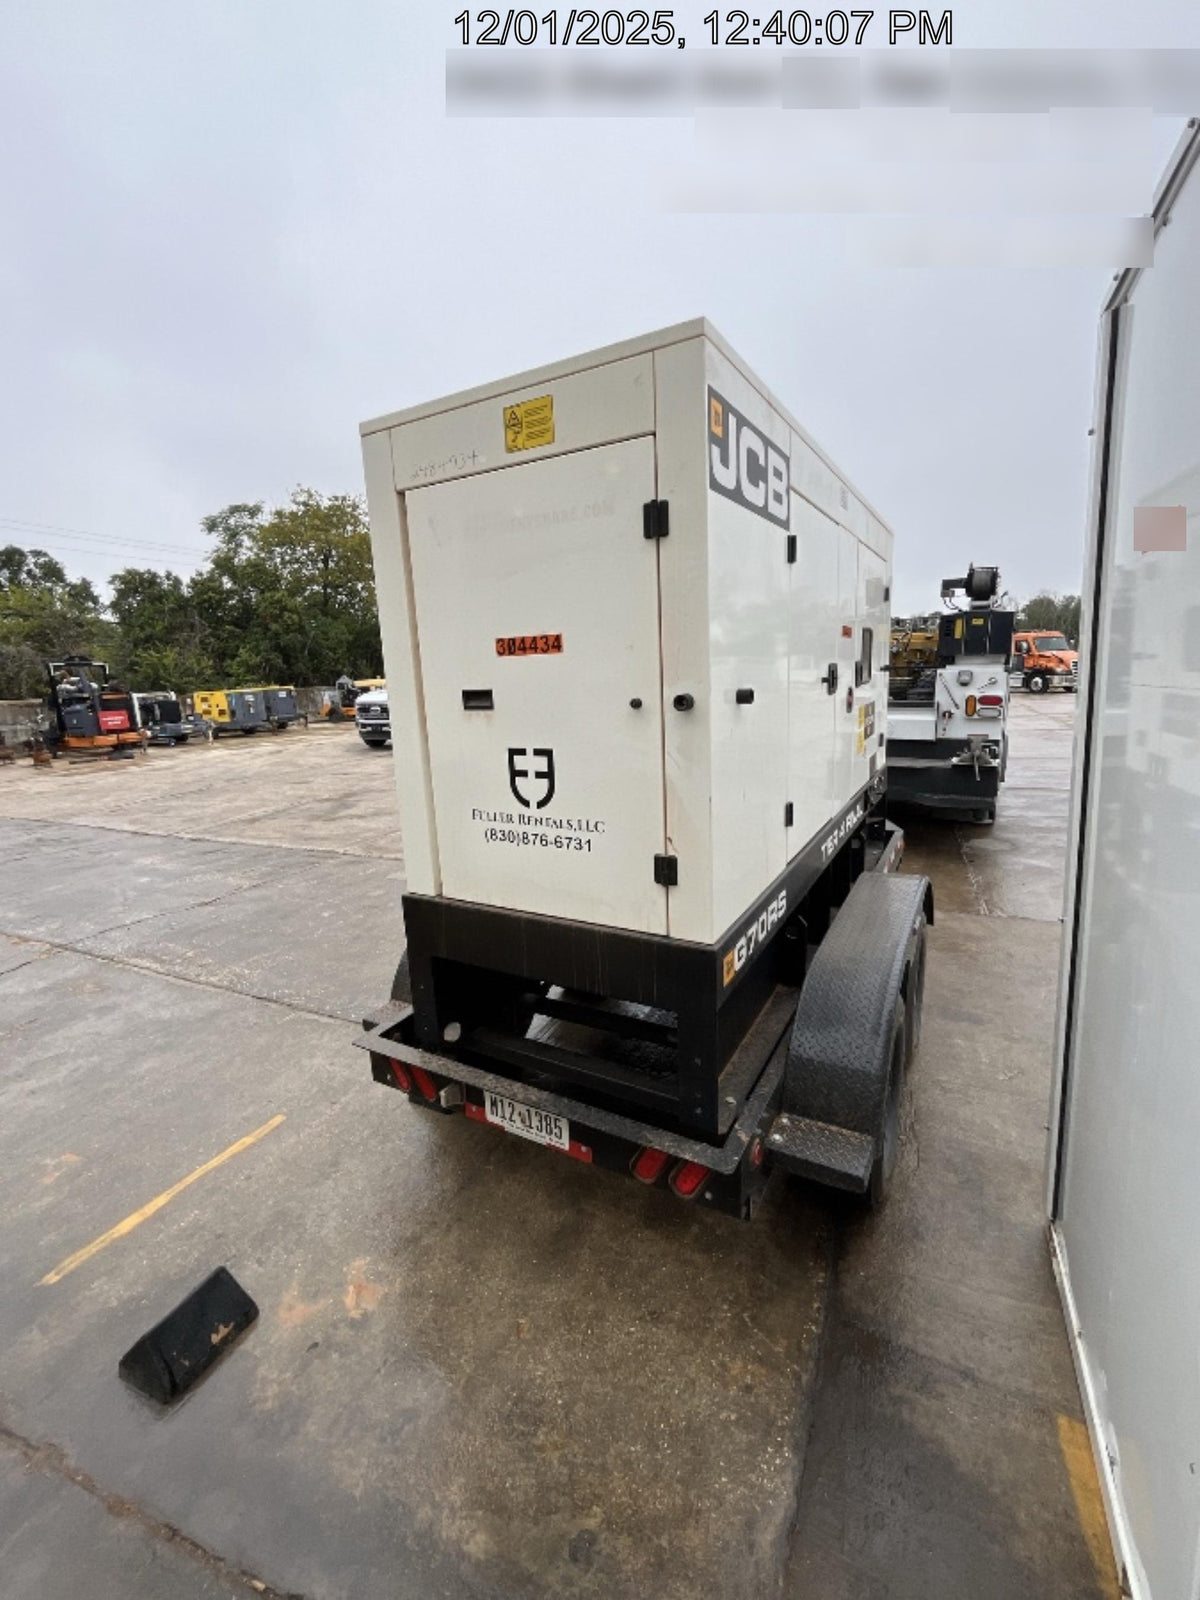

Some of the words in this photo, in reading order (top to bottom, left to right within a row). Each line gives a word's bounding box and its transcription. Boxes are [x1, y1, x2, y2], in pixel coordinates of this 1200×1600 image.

[710, 409, 789, 524] JCB
[496, 634, 563, 656] 304434
[472, 808, 514, 824] FULLER
[484, 828, 592, 852] (830)876-6731
[734, 889, 787, 971] G70RS
